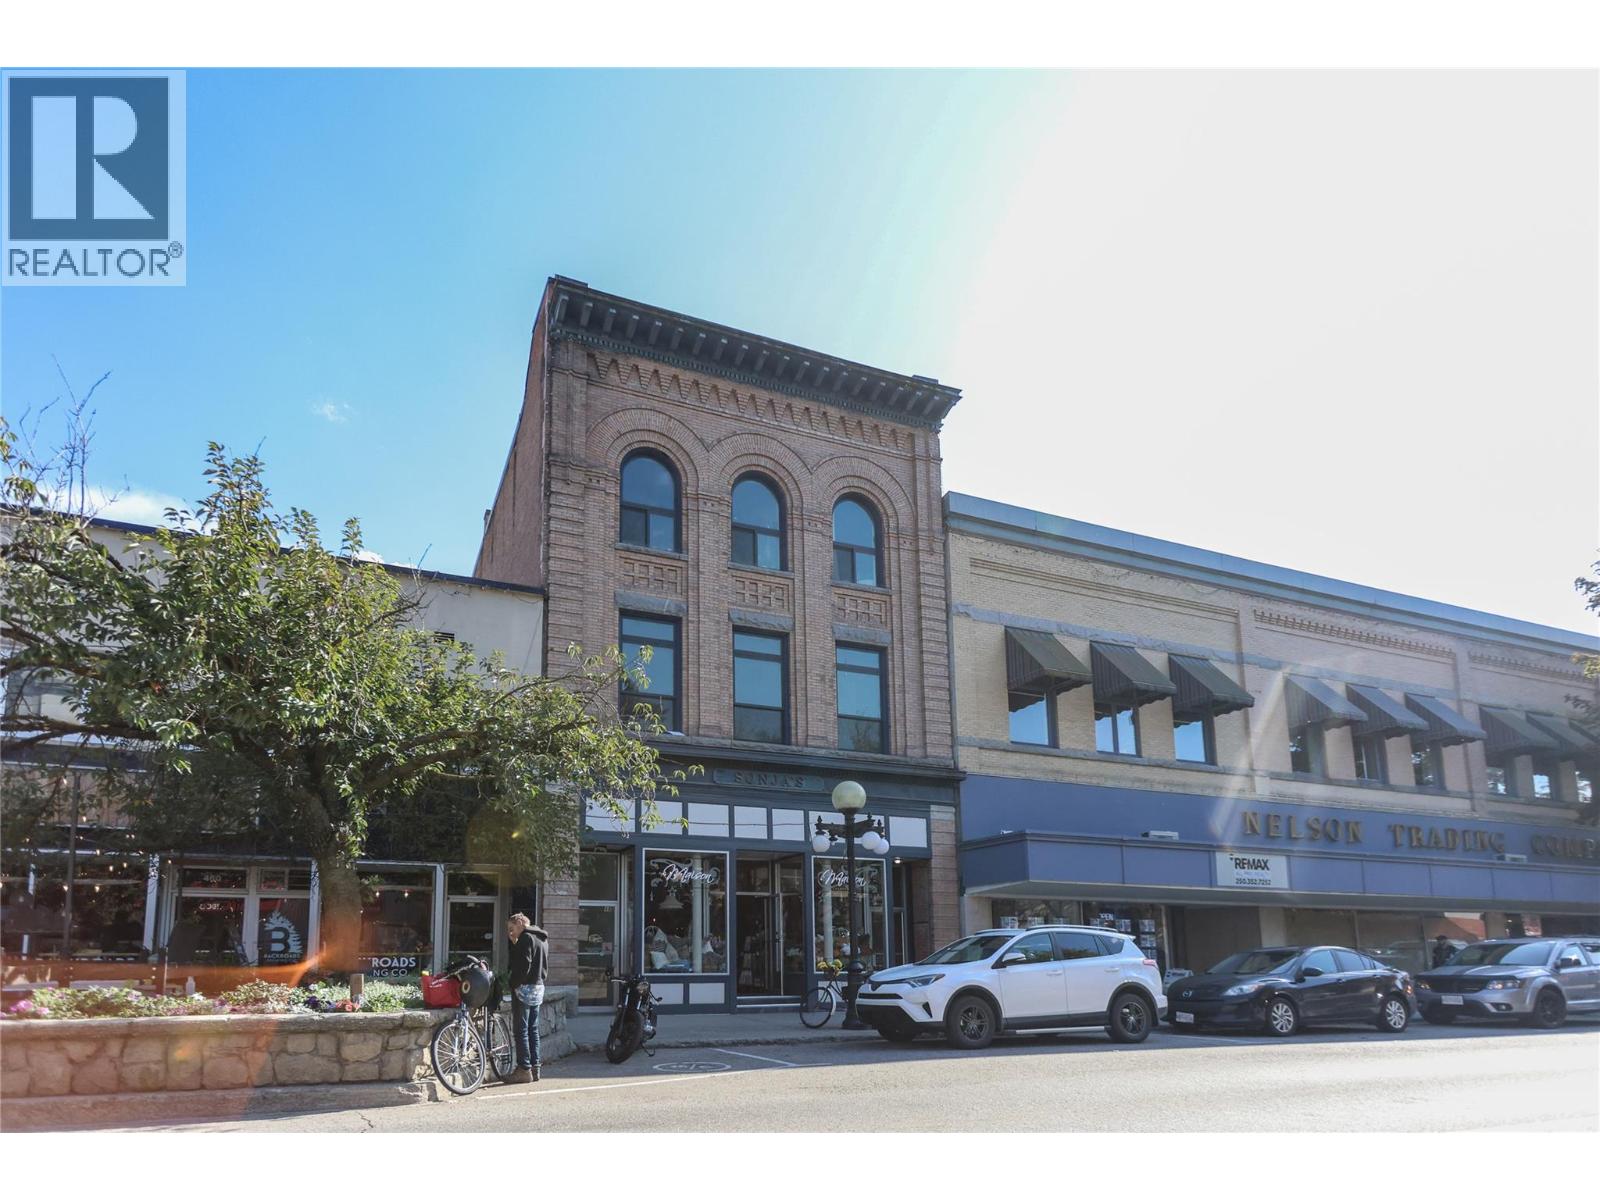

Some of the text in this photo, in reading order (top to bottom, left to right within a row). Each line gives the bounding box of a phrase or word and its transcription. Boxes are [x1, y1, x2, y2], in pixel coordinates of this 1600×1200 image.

[1241, 811, 1363, 844] NELSON
[1386, 823, 1505, 854] TRADING
[661, 863, 716, 884] Maison
[357, 956, 416, 968] ROADS
